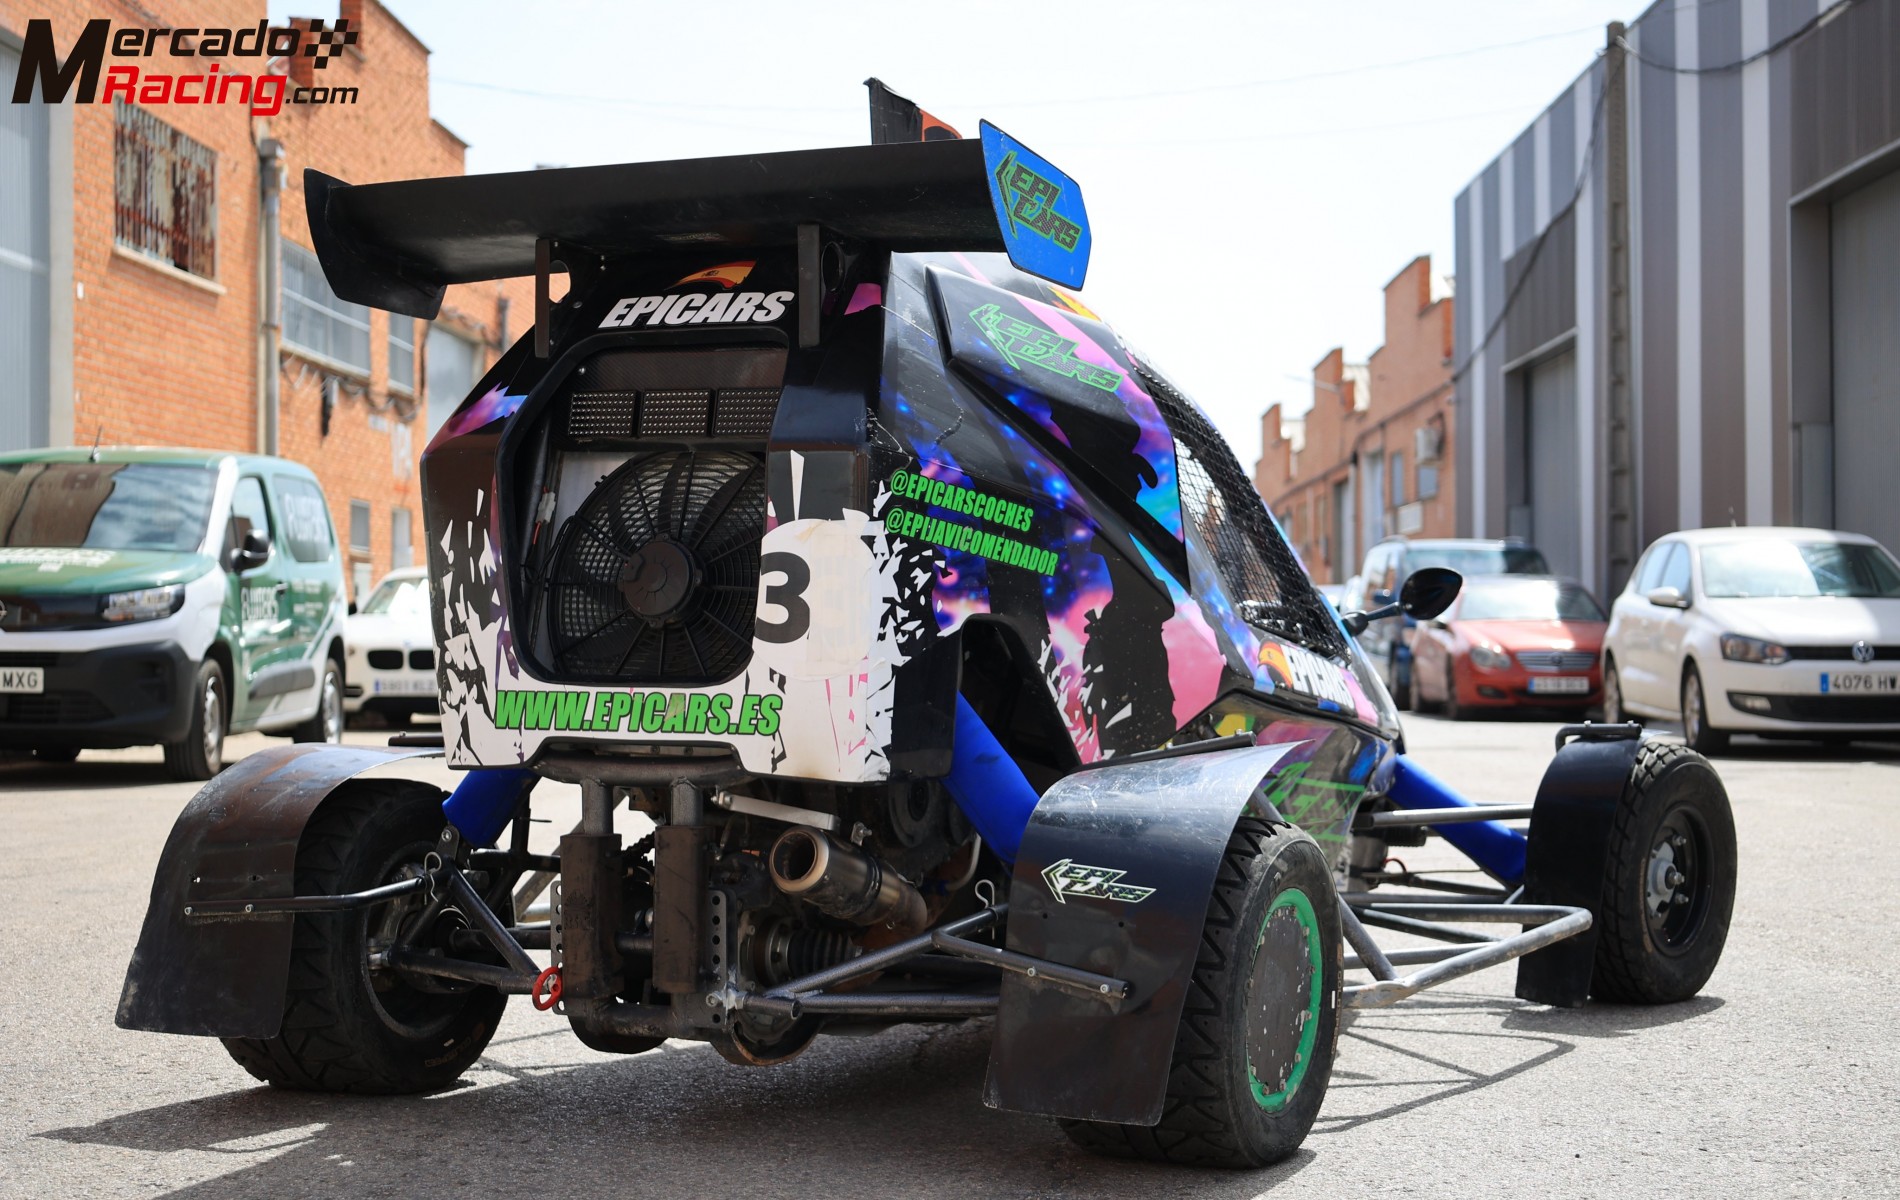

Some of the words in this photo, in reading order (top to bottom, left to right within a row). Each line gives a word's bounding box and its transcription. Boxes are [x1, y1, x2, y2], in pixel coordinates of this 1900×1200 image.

[1009, 161, 1061, 211] EPI
[1012, 192, 1082, 253] CARS
[598, 290, 795, 329] EPICARS
[890, 469, 1034, 532] @EPICARSCOCHES
[886, 507, 1059, 577] @EPIJAVICOMENDADOR
[2, 671, 38, 689] MXG
[1280, 644, 1355, 710] EPICARS
[1833, 674, 1873, 690] 4076
[495, 690, 783, 736] WWW.EPICARS.ES
